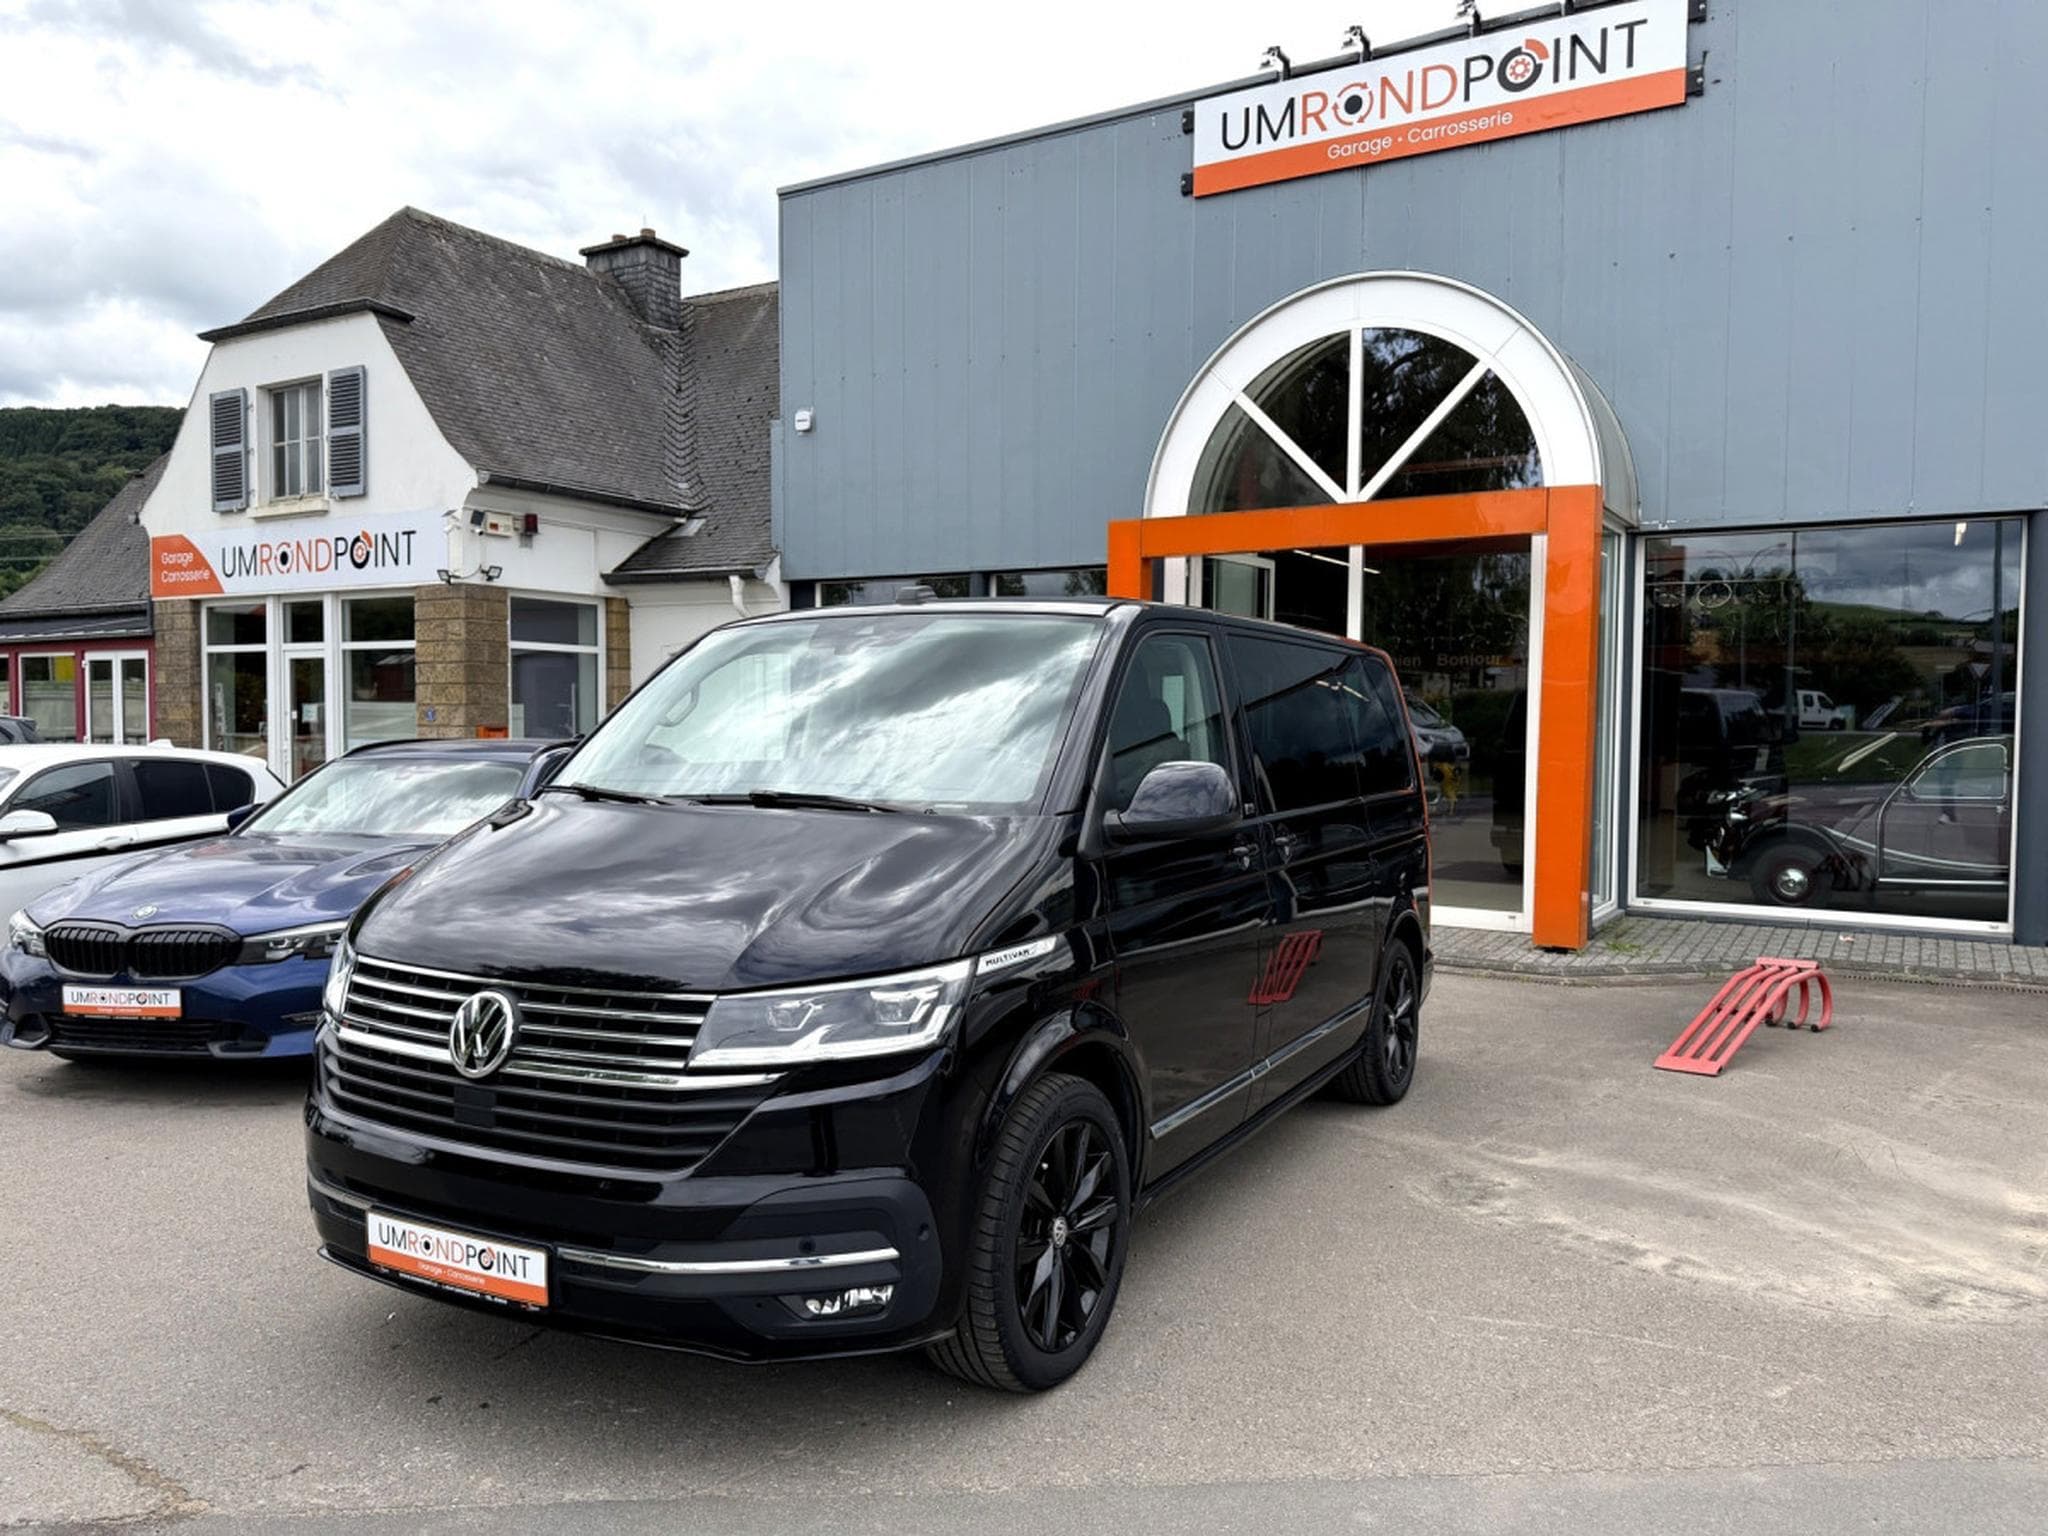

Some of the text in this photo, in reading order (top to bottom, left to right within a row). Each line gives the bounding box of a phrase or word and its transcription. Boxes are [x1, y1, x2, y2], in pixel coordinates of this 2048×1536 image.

[1221, 18, 1648, 151] UMRONDPOINT
[1327, 110, 1513, 161] Garage Carrosserie
[161, 552, 194, 567] Garage
[161, 568, 210, 583] Carrosserie
[221, 530, 417, 578] UMRONDPOINT
[985, 948, 1030, 967] MULTIVAN
[378, 1222, 531, 1279] UMRONDPOINT
